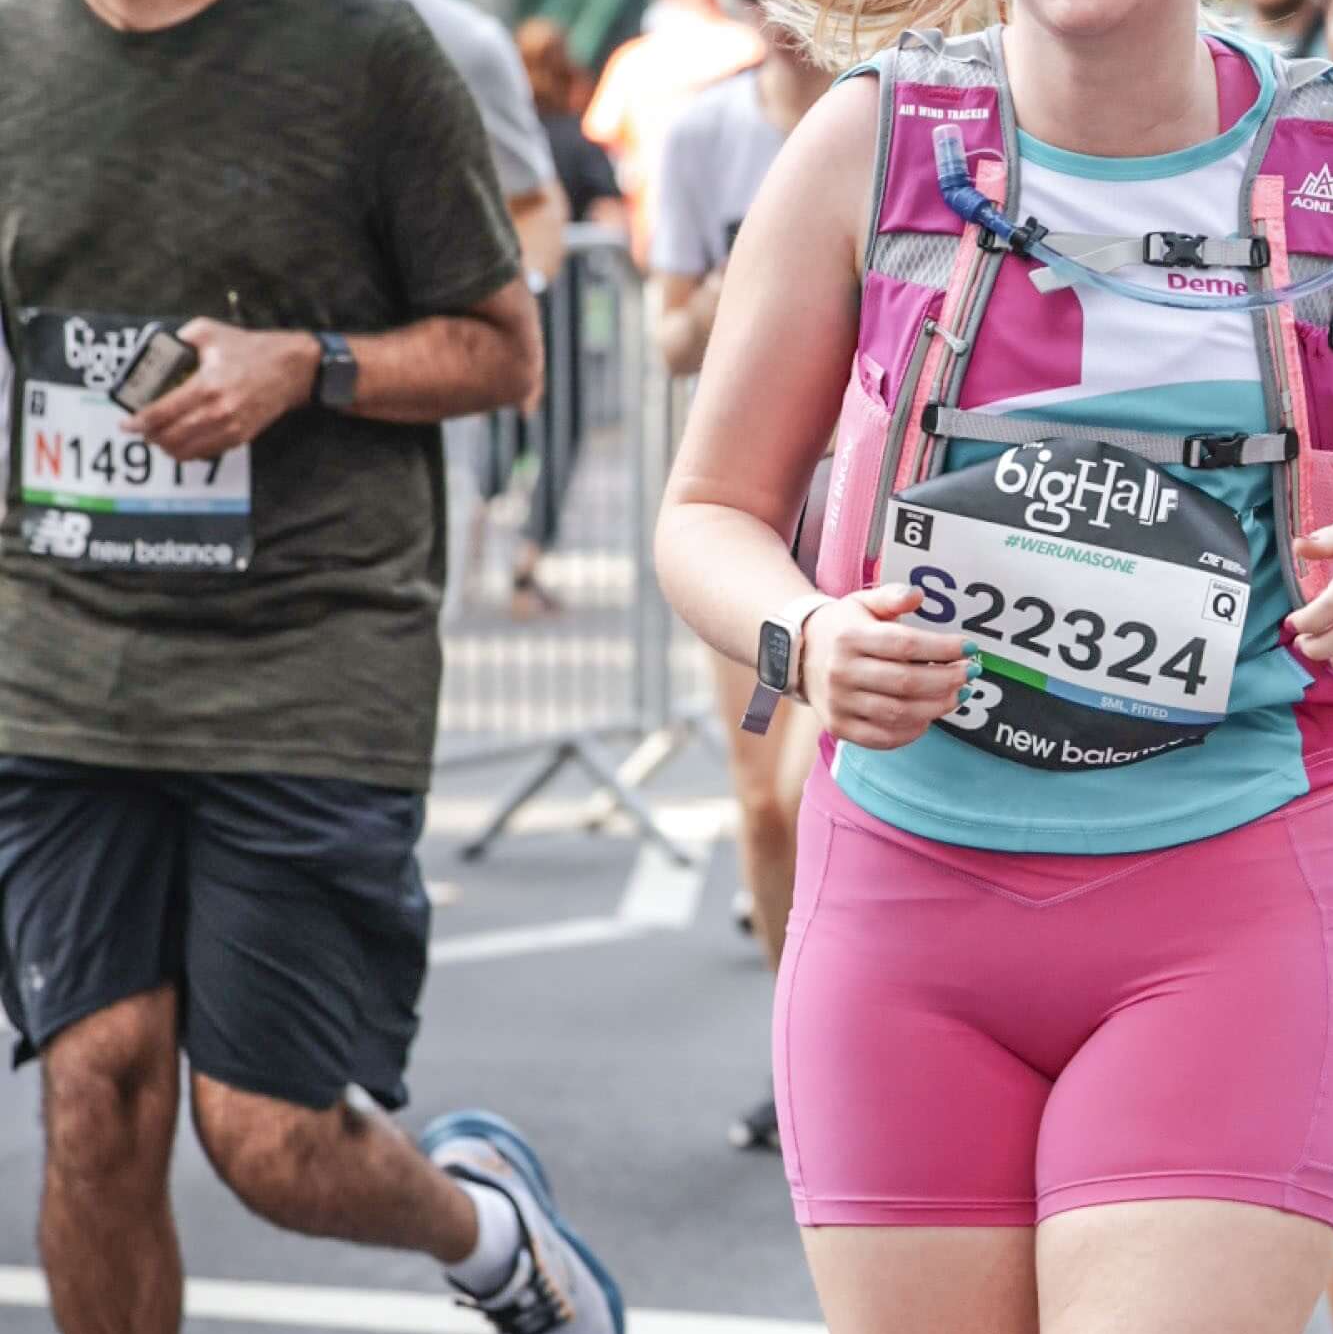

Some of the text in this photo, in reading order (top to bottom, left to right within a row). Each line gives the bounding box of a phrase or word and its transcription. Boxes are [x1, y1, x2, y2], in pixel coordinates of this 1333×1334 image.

[898, 104, 990, 121] AIR WIND TRACKER
[904, 521, 923, 546] 6
[1004, 533, 1138, 575] #WERUNASONE
[1212, 592, 1236, 621] Q
[909, 564, 1208, 696] S22324
[995, 721, 1056, 759] new
